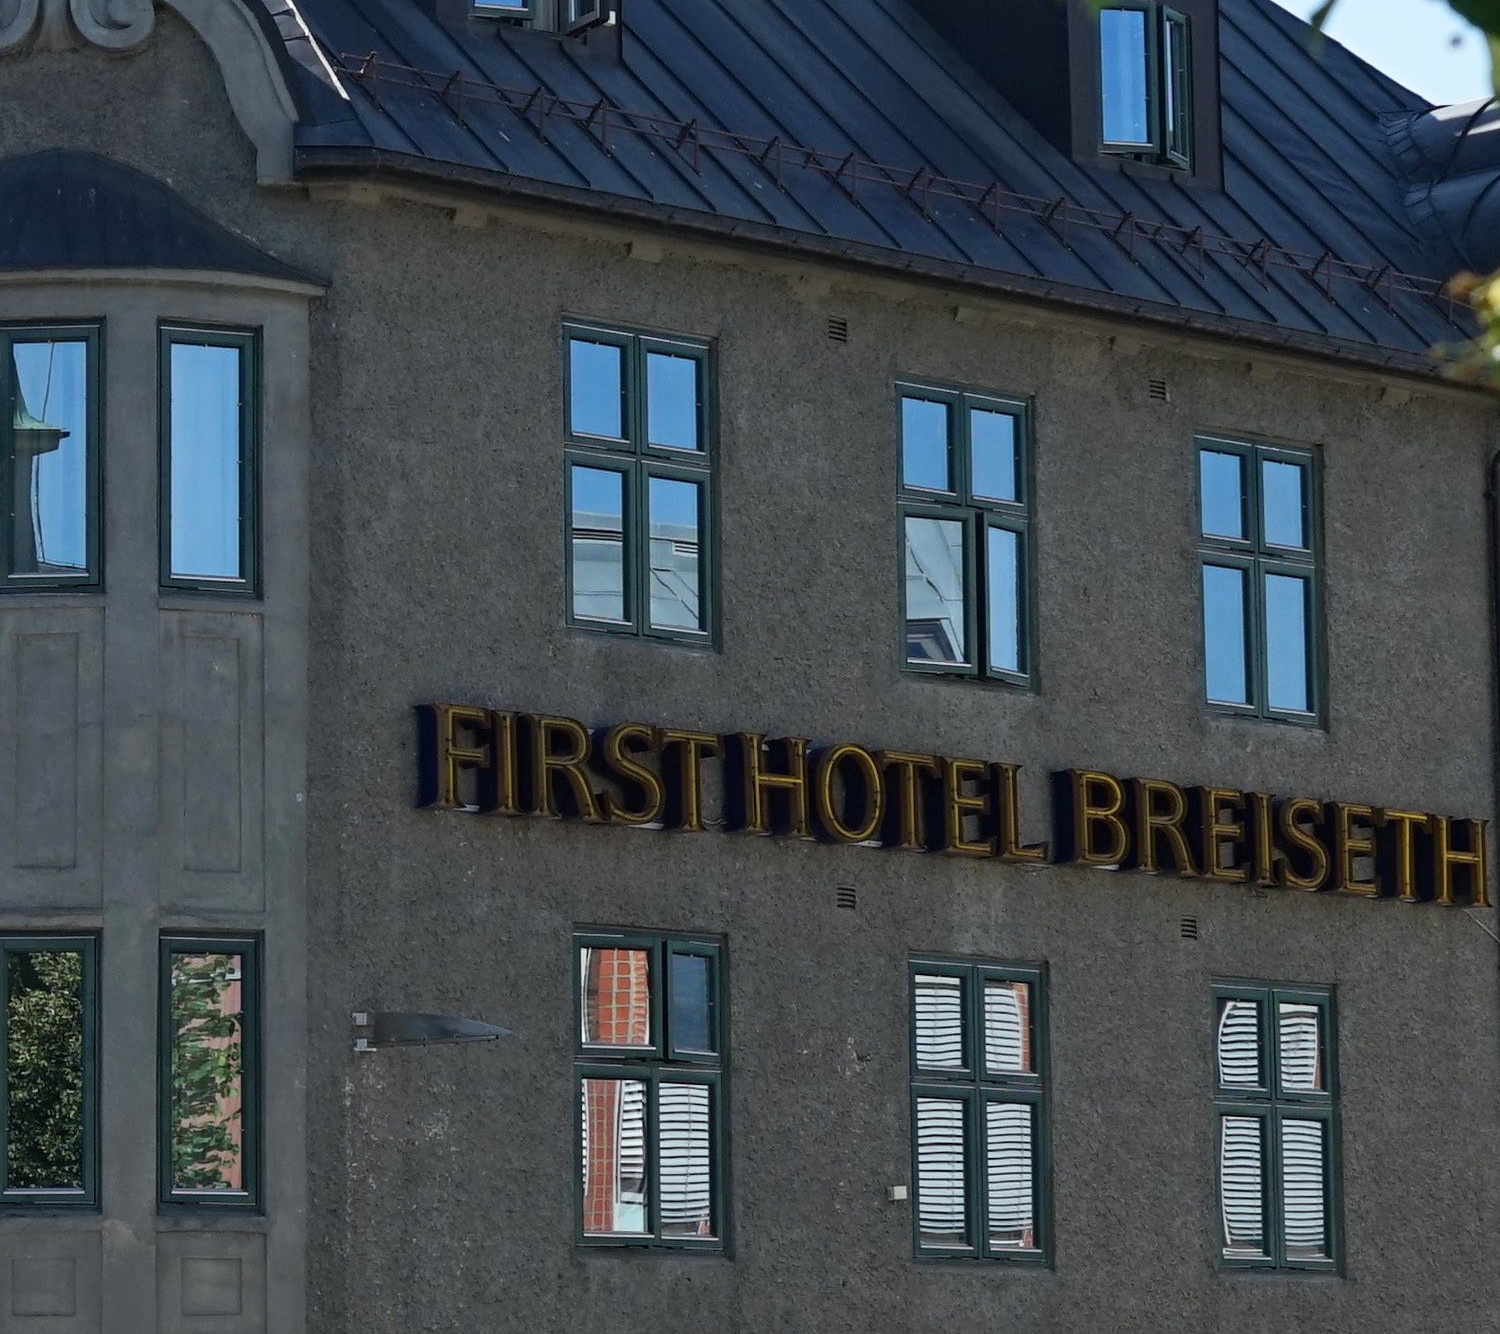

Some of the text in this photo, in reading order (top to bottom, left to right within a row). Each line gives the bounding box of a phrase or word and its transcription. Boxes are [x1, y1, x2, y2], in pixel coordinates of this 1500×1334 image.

[422, 700, 1492, 908] FIRST HOTEL BREISETH
